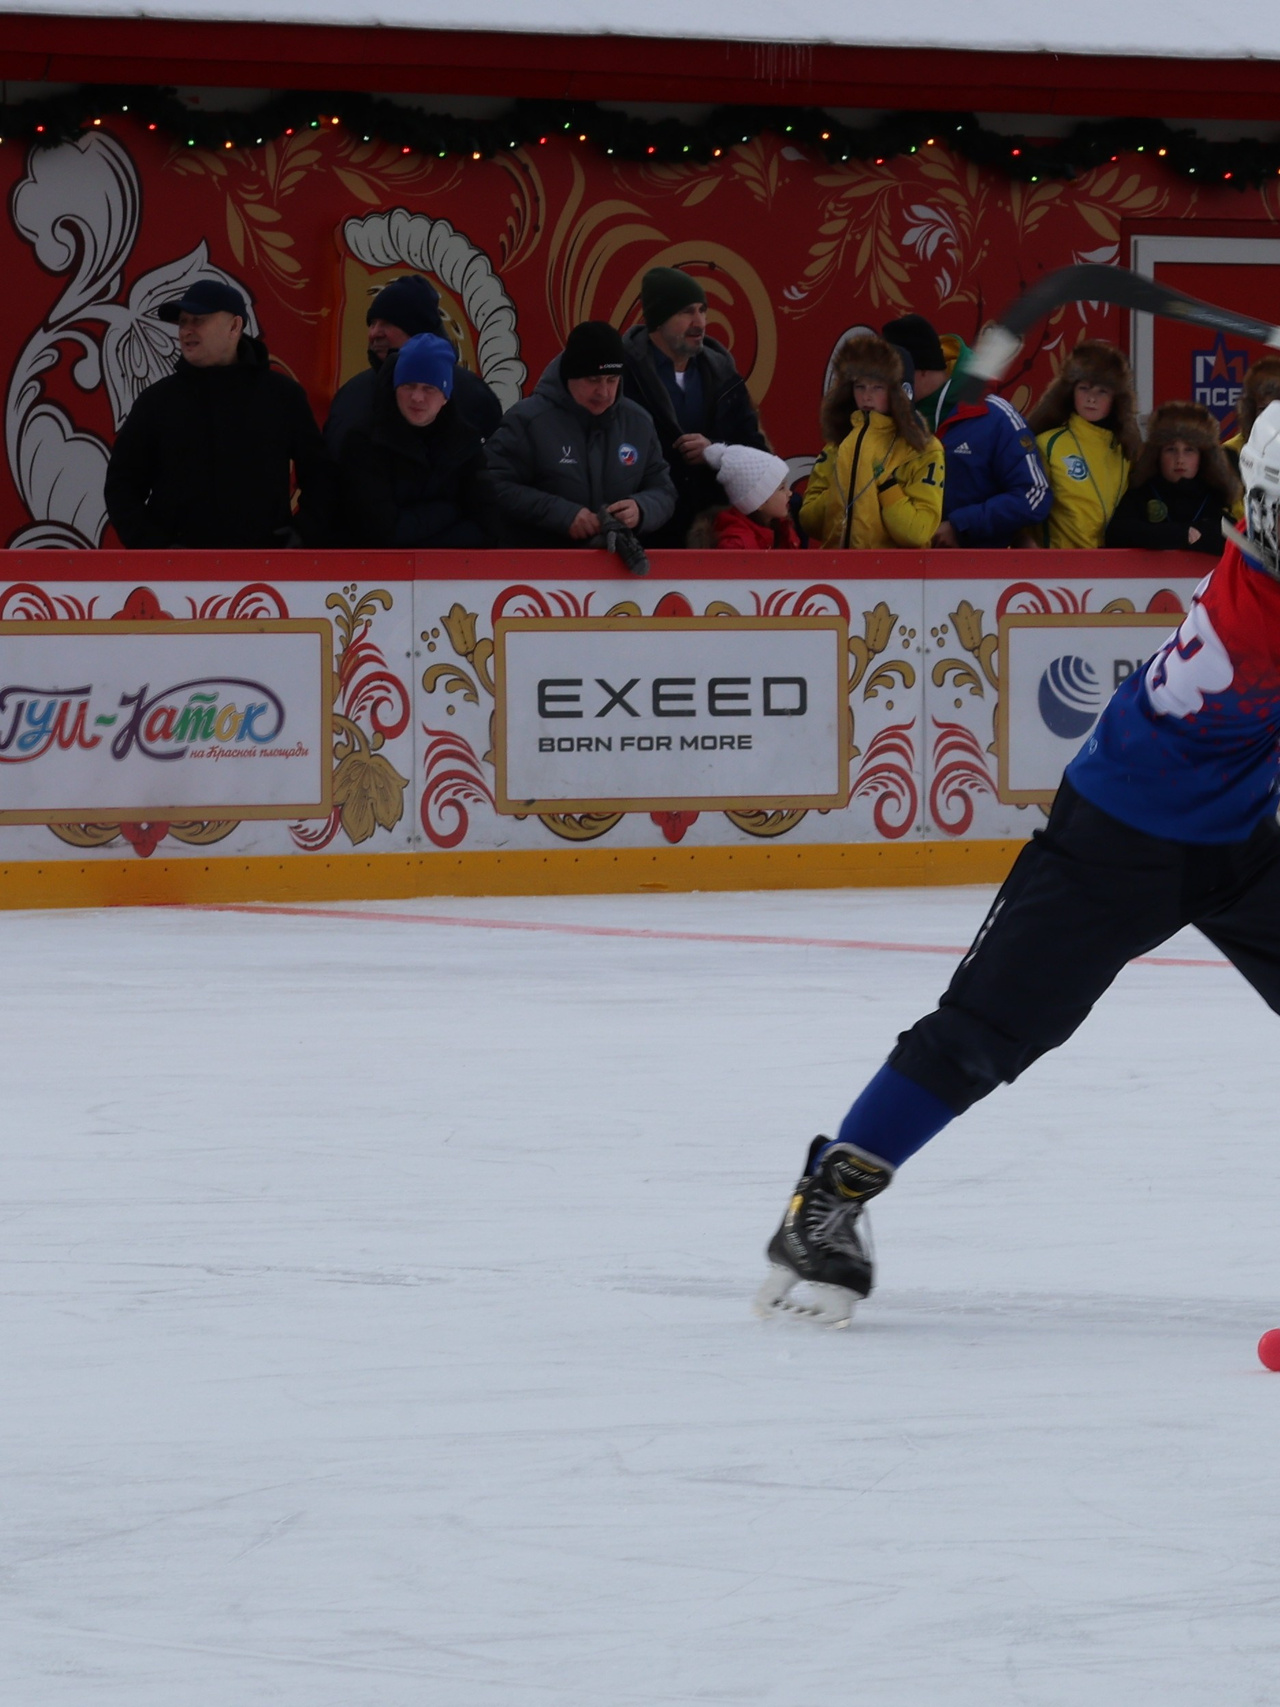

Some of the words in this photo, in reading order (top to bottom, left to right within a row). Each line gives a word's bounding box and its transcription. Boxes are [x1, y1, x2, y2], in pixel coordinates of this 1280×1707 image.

[537, 676, 808, 719] EXEED
[259, 742, 309, 760] площади
[538, 737, 613, 752] BORN
[620, 736, 673, 751] FOR
[680, 734, 753, 750] MORE
